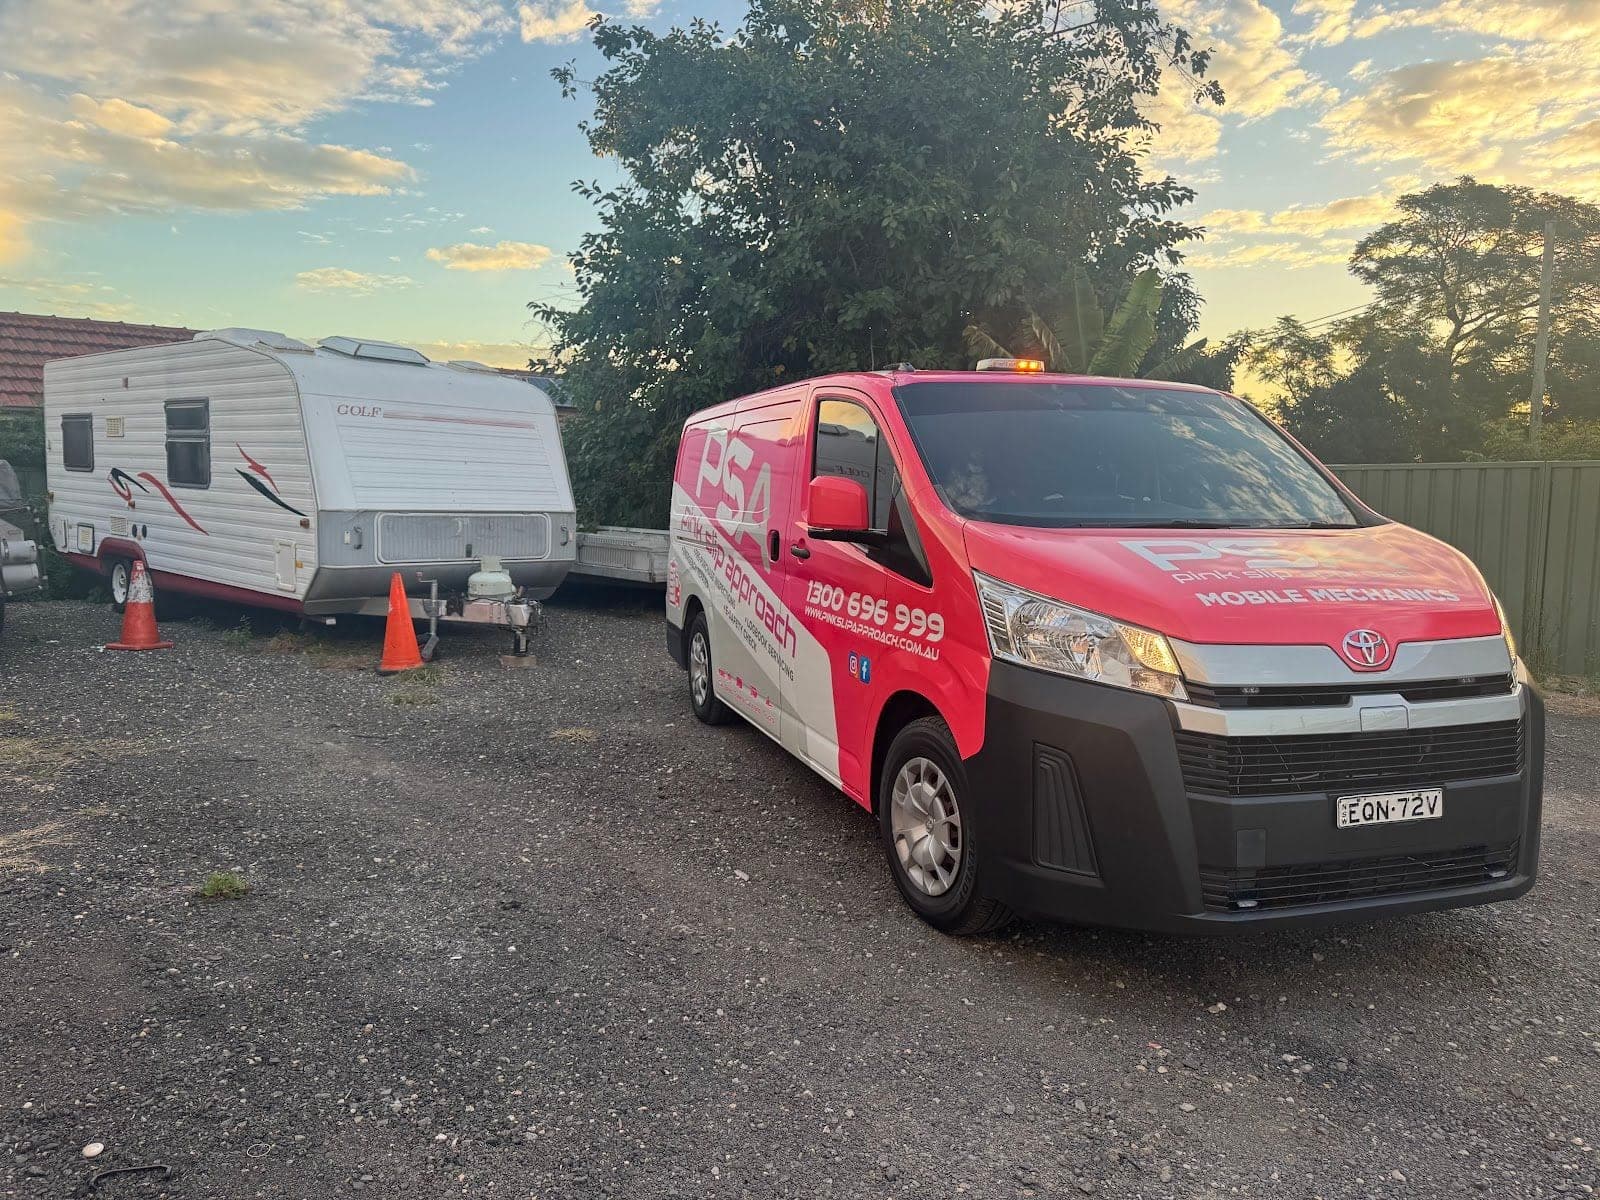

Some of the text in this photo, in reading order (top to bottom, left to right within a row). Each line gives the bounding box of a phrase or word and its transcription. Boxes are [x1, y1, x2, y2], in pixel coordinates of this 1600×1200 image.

[337, 404, 382, 418] GOLF
[696, 428, 771, 574] PSA
[1117, 539, 1400, 572] PS
[1171, 569, 1242, 584] pink
[1242, 568, 1293, 580] slip
[725, 555, 797, 659] approach
[805, 580, 945, 643] 1300 696 999
[1195, 587, 1461, 607] MOBILE MECHANICS
[804, 605, 940, 661] WWW.PINKSLIPAPPROACH.COM.AU
